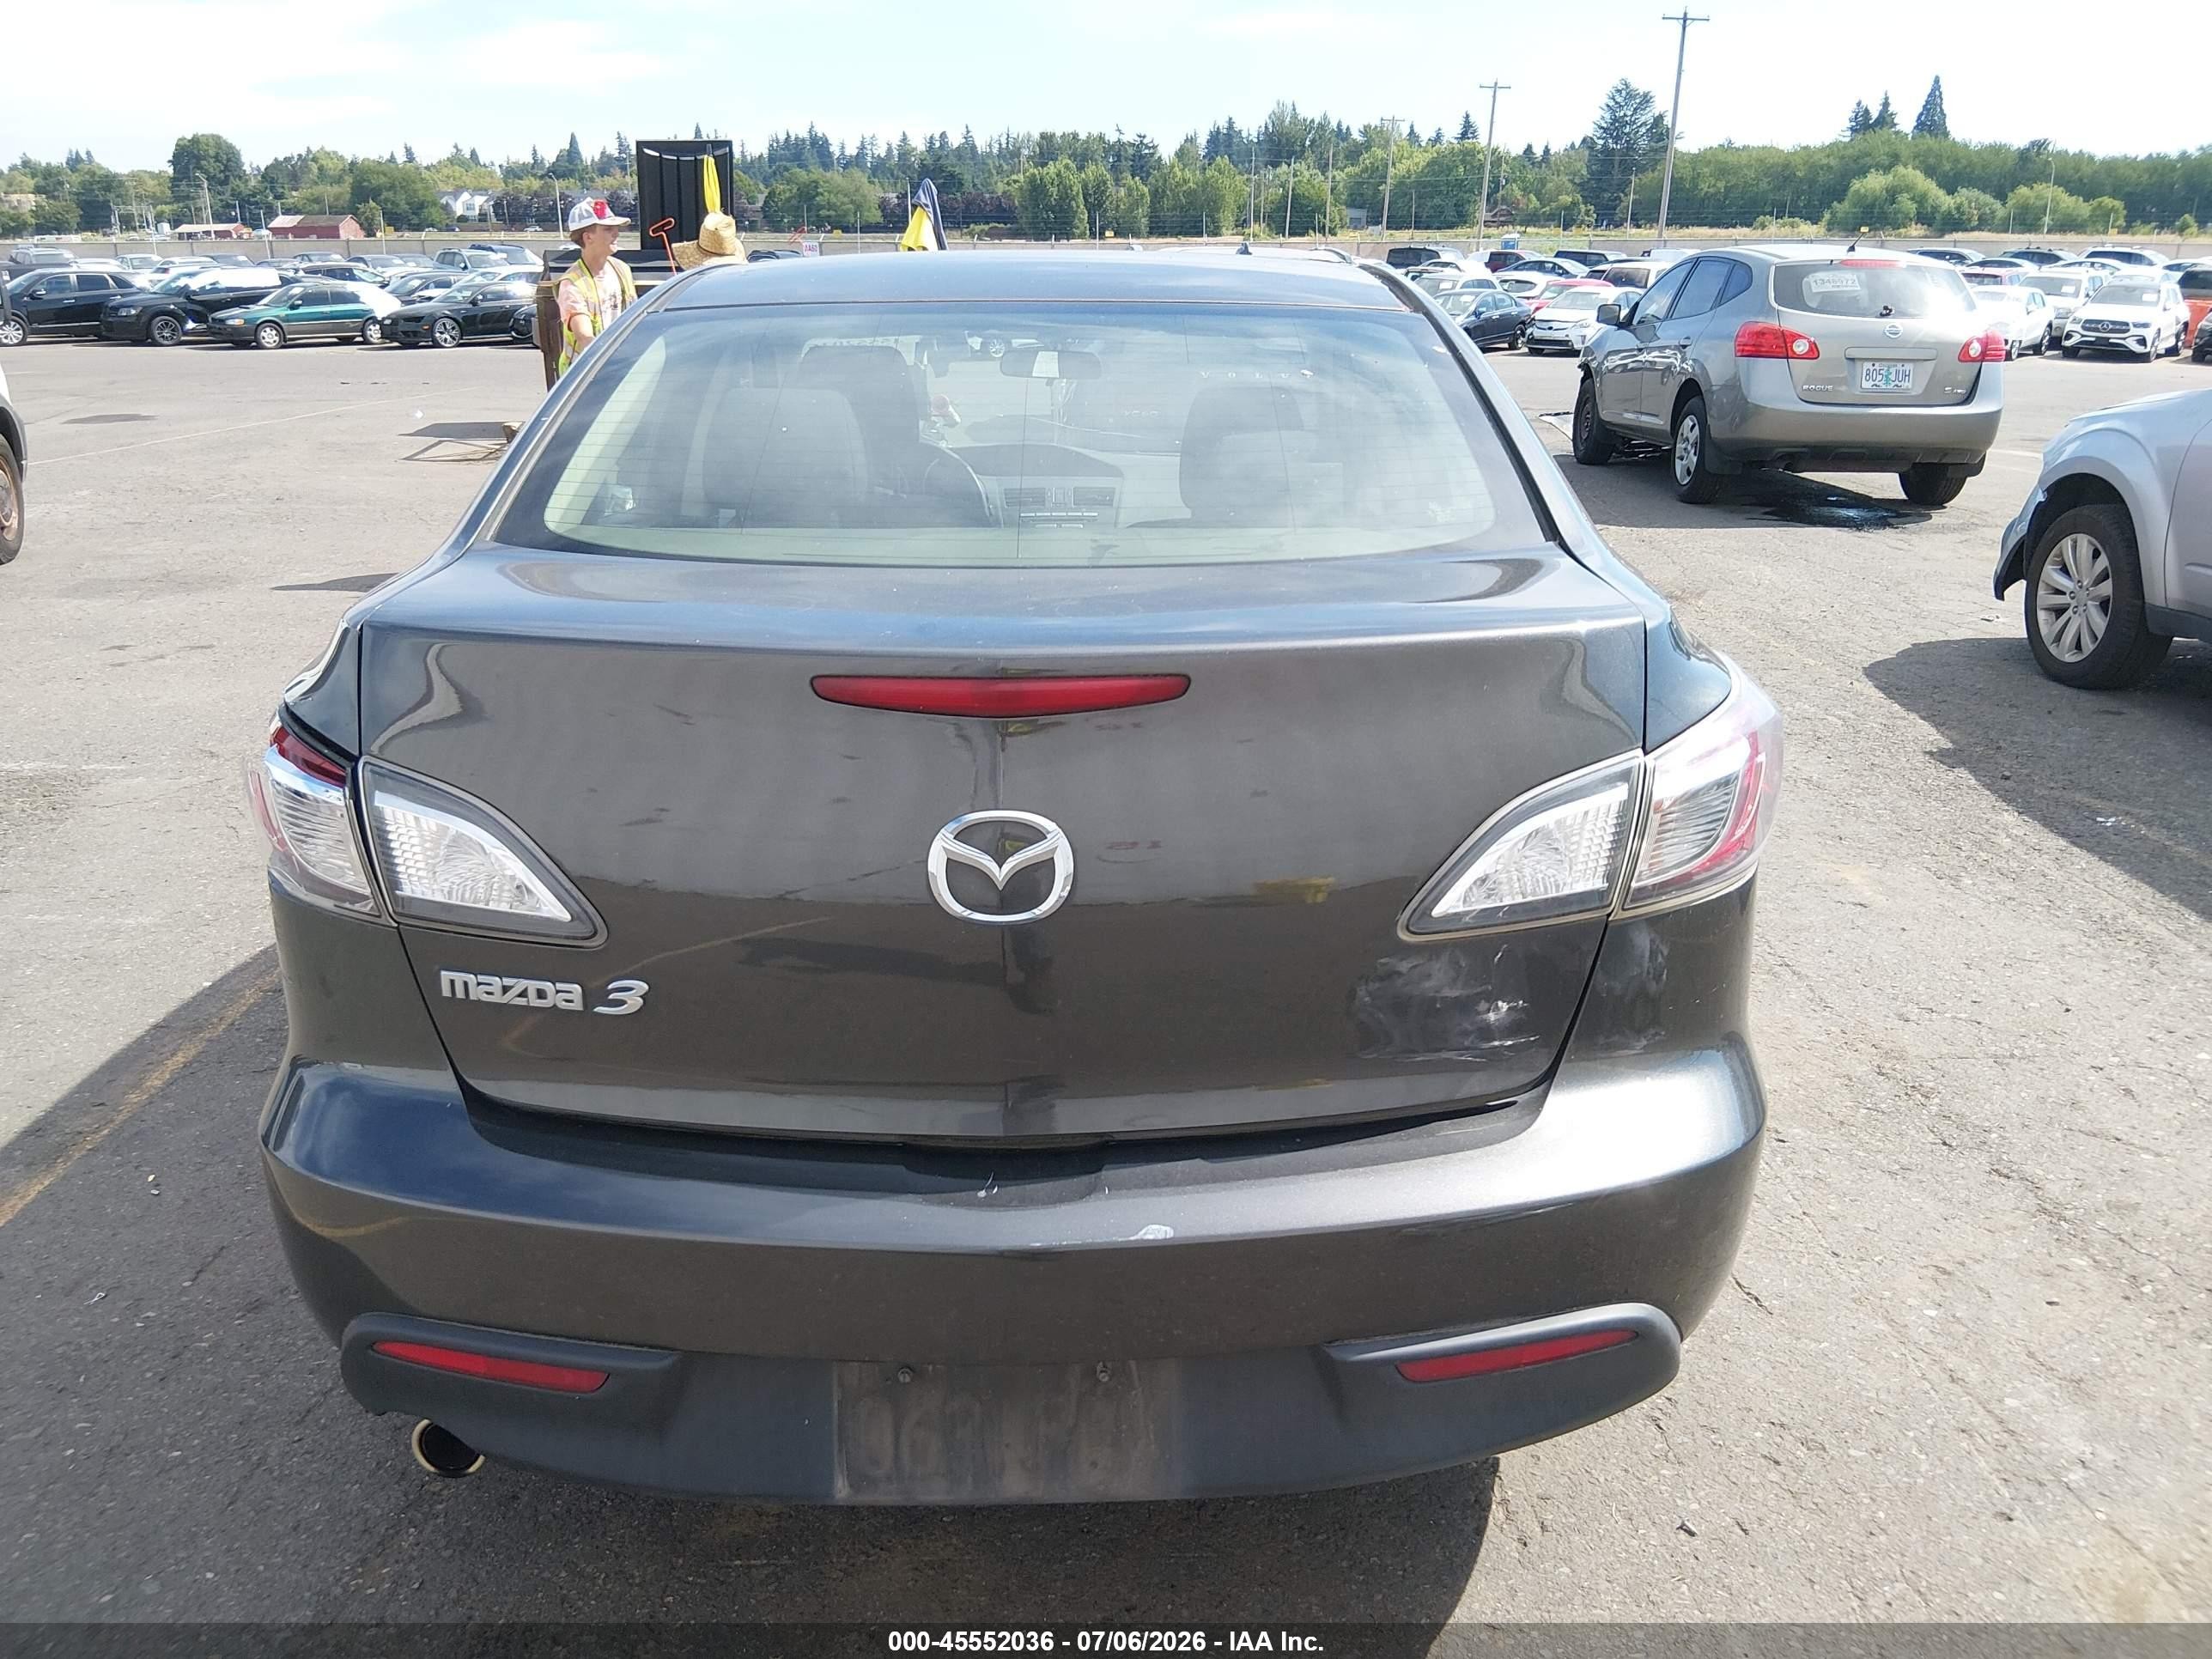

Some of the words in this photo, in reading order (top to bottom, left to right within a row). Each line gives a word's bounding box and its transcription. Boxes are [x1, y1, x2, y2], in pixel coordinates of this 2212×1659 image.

[1864, 368, 1885, 383] 805
[1890, 368, 1911, 383] JUH
[592, 979, 650, 1015] 3
